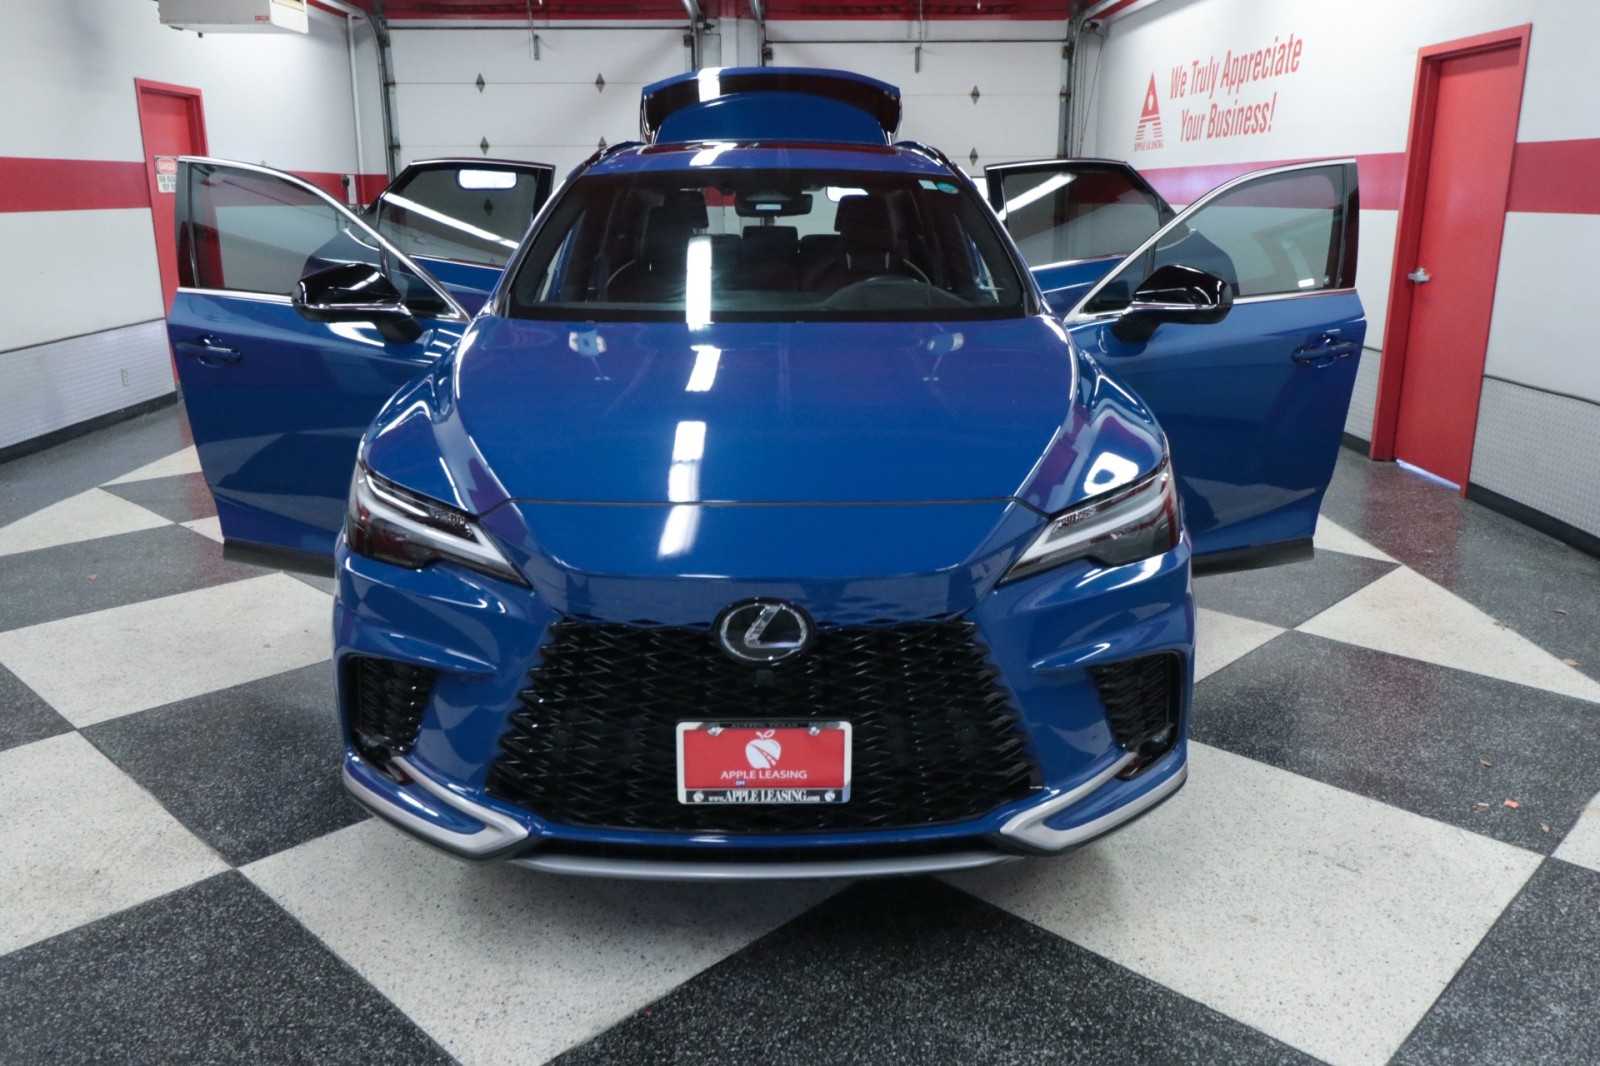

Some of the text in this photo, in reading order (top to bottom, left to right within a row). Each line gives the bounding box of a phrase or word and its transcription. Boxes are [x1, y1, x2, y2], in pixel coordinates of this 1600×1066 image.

[1170, 33, 1303, 99] We Truly Appreciate
[1180, 91, 1277, 142] Your Business!
[721, 770, 807, 780] APPLE LEASING
[708, 789, 820, 802] www.APPLE LEASING.com
